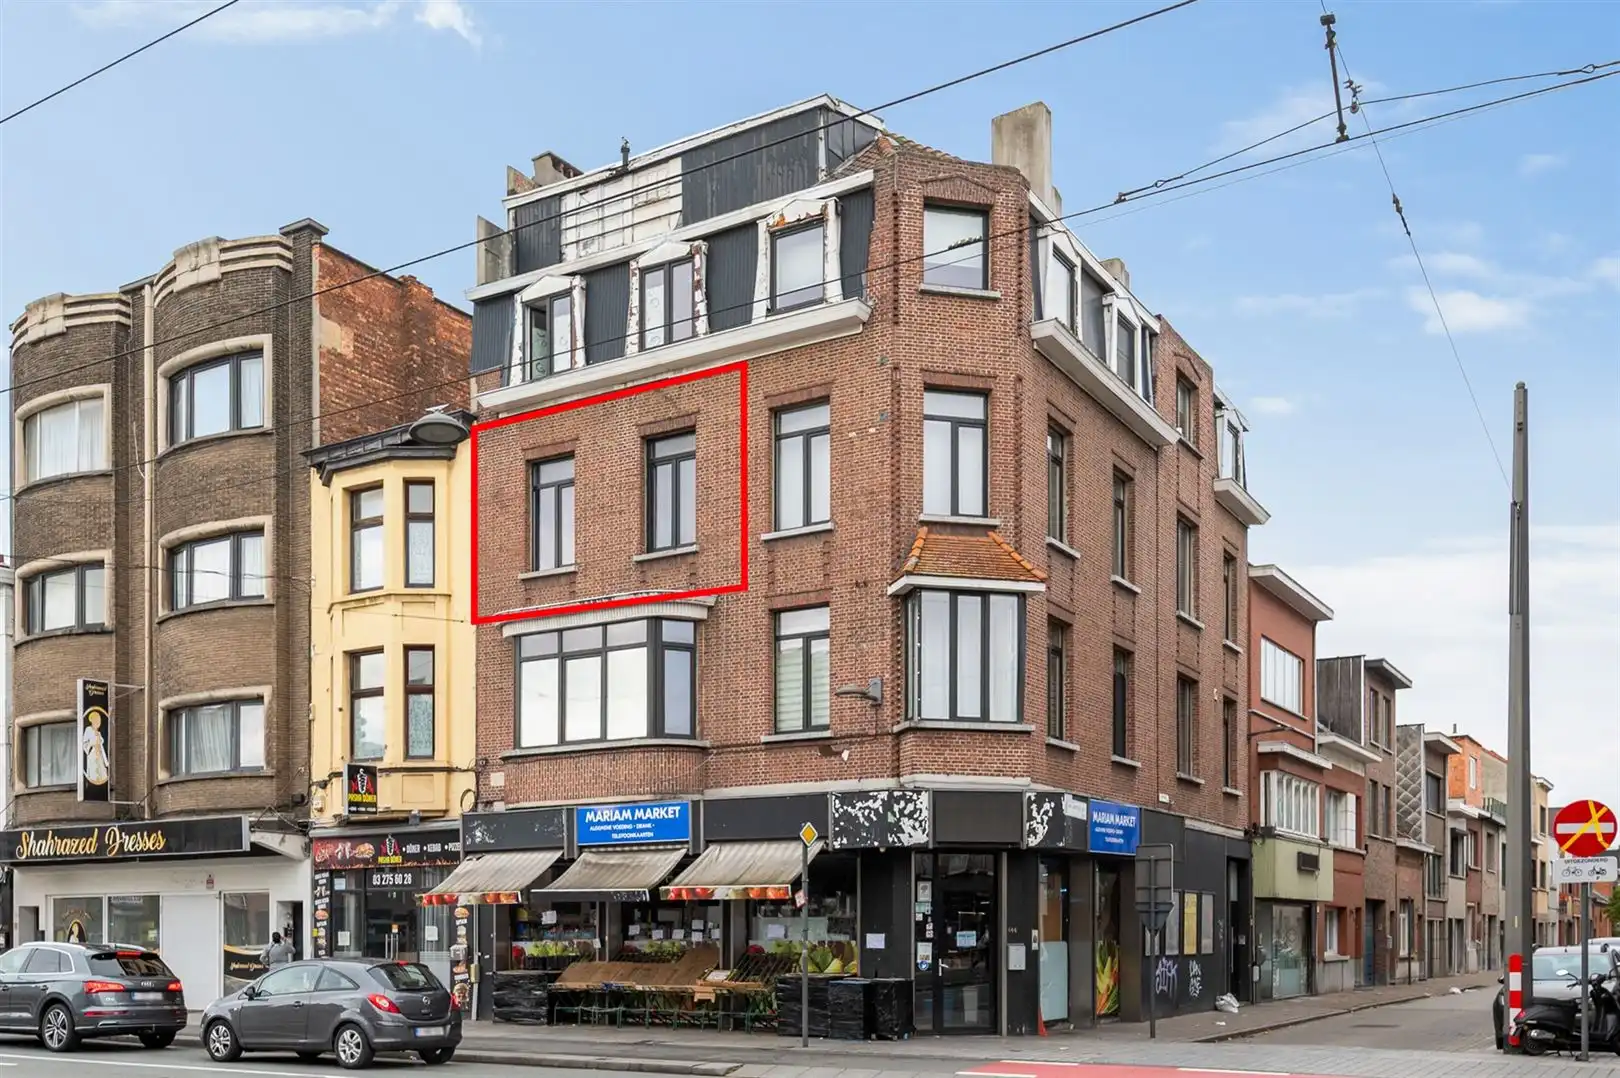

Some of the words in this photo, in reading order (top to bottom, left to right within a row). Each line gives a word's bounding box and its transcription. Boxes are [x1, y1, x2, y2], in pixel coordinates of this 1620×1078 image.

[585, 809, 632, 823] MARIAM
[634, 806, 680, 820] MARKET
[1093, 811, 1114, 824] MARIAM
[1115, 814, 1136, 828] MARKET
[15, 828, 98, 860] Shahrazed
[104, 826, 166, 856] Dresses
[373, 874, 381, 885] 03
[382, 874, 393, 885] 275
[403, 873, 412, 884] 28
